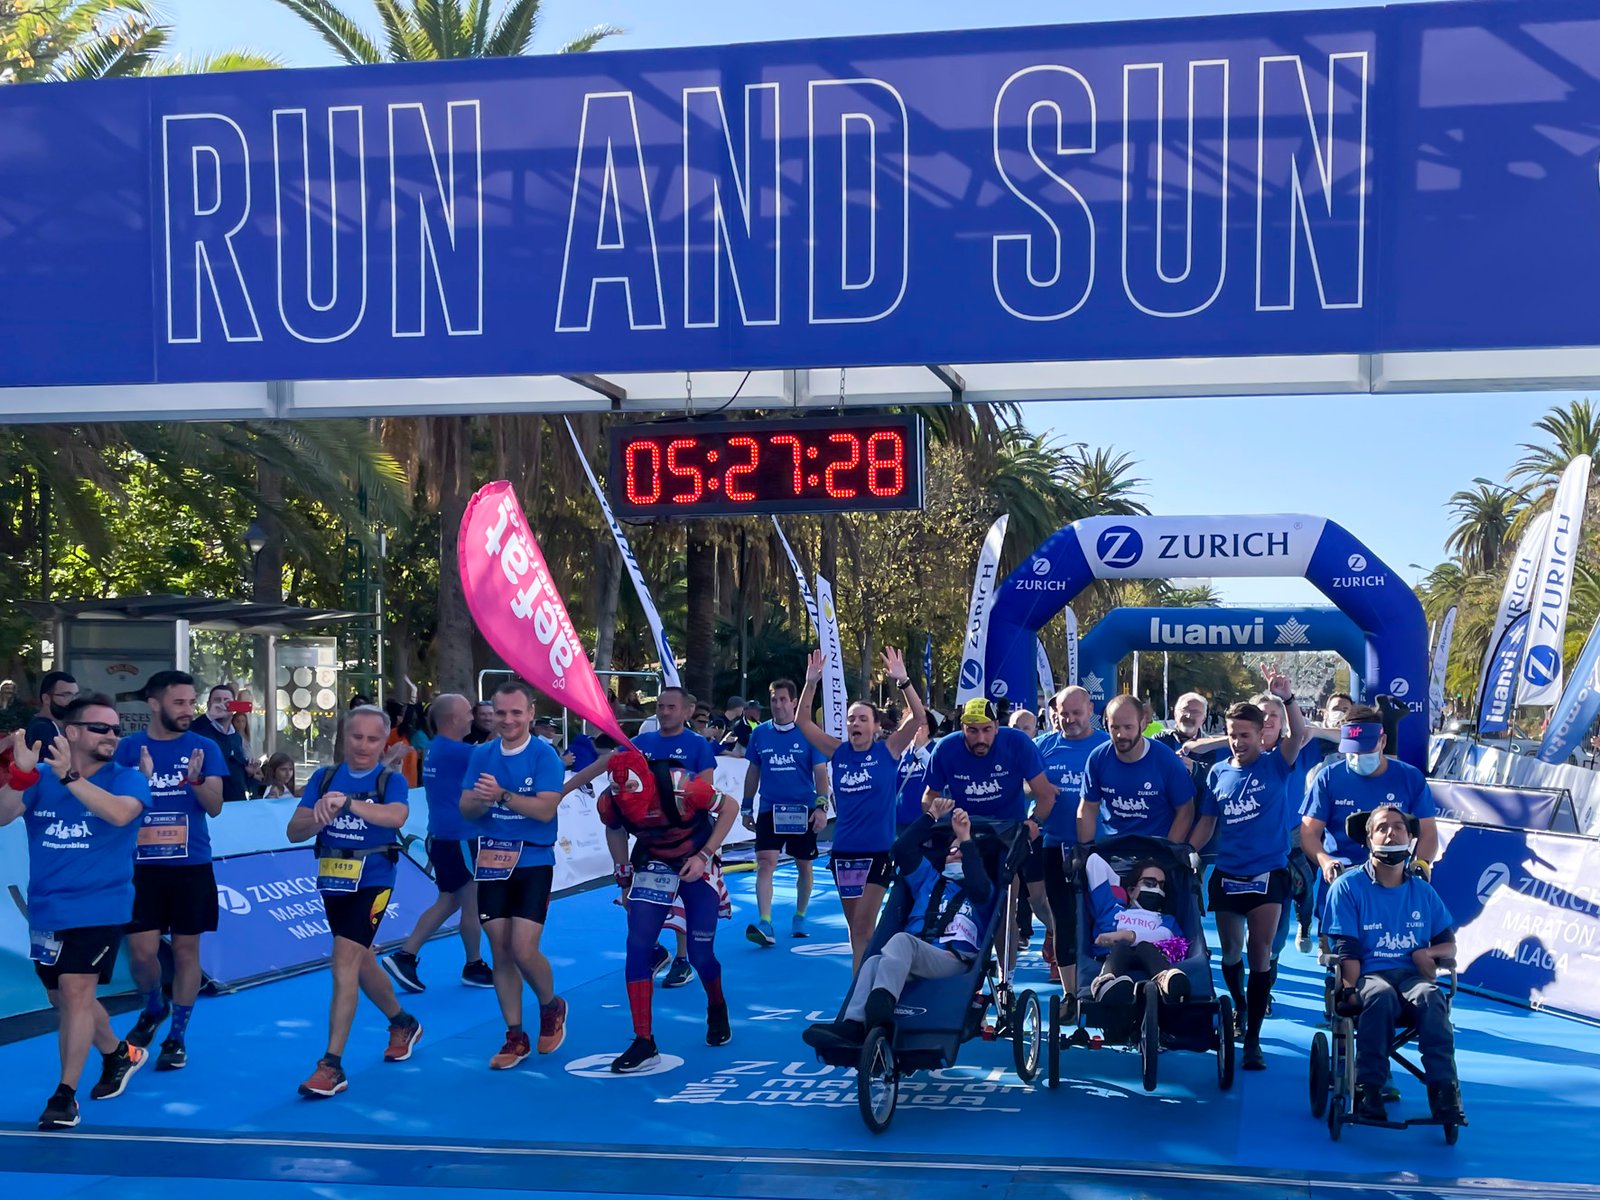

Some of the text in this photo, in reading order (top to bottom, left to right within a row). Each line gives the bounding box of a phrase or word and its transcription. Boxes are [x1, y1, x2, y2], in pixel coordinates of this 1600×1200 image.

[162, 51, 1368, 343] RUN AND SUN
[625, 431, 904, 504] 05:27:28
[1158, 532, 1290, 559] ZURICH
[485, 502, 573, 678] aefat
[1016, 579, 1066, 591] ZURICH
[1332, 576, 1385, 588] ZURICH
[1539, 514, 1570, 634] ZURICH
[1150, 617, 1264, 645] luanvi
[1486, 650, 1518, 723] luanvi
[1501, 911, 1596, 947] MARATÓN
